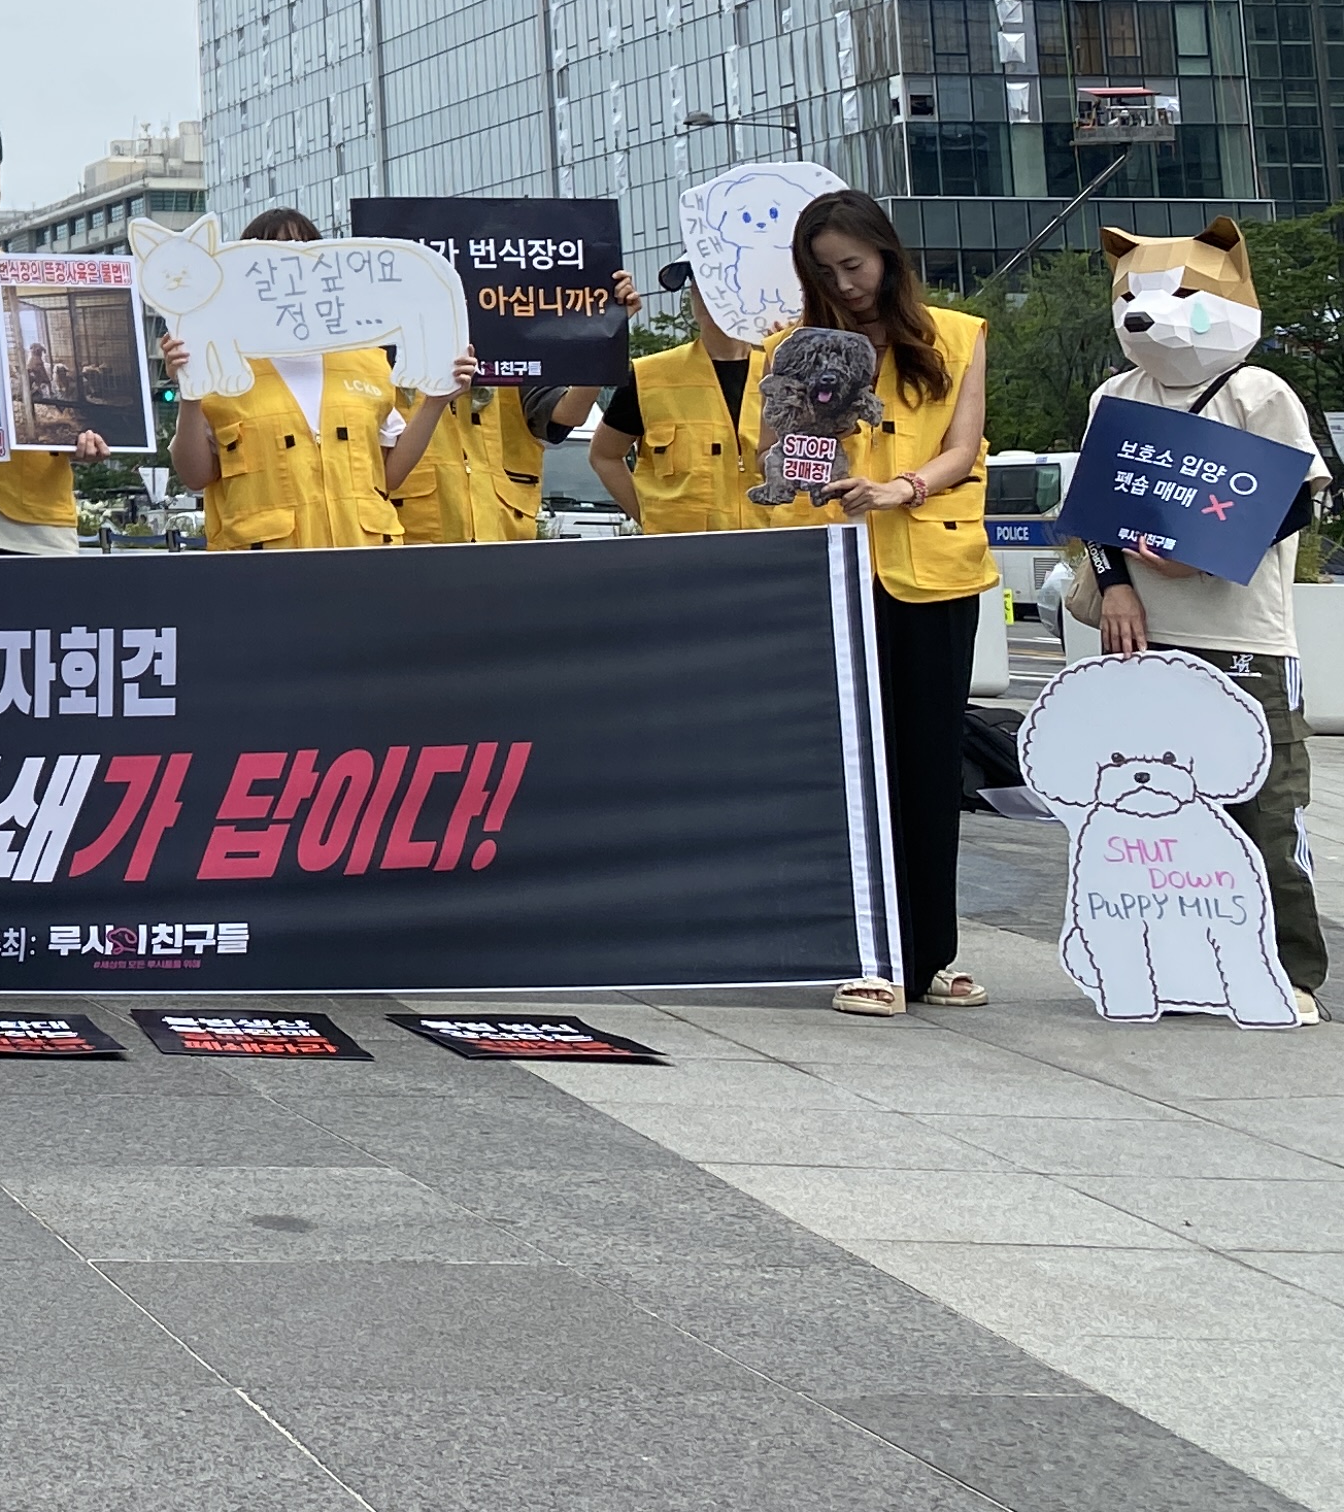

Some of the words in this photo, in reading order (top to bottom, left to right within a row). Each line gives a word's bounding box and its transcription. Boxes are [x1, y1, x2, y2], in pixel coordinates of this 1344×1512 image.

[469, 238, 584, 270] 번식장의
[99, 260, 132, 285] 불법!!
[478, 286, 609, 317] 아십니까?
[343, 379, 382, 397] LCKD
[785, 435, 835, 458] STOP!
[785, 460, 831, 482] 경매장!
[1117, 440, 1174, 468] 보호소
[1179, 455, 1228, 484] 입양
[1114, 470, 1149, 496] 펫숍
[1153, 480, 1198, 508] 매매
[997, 526, 1029, 541] POLICE
[194, 741, 532, 883] 답이다!
[1104, 836, 1178, 865] SHUT
[1178, 894, 1248, 926] MILS
